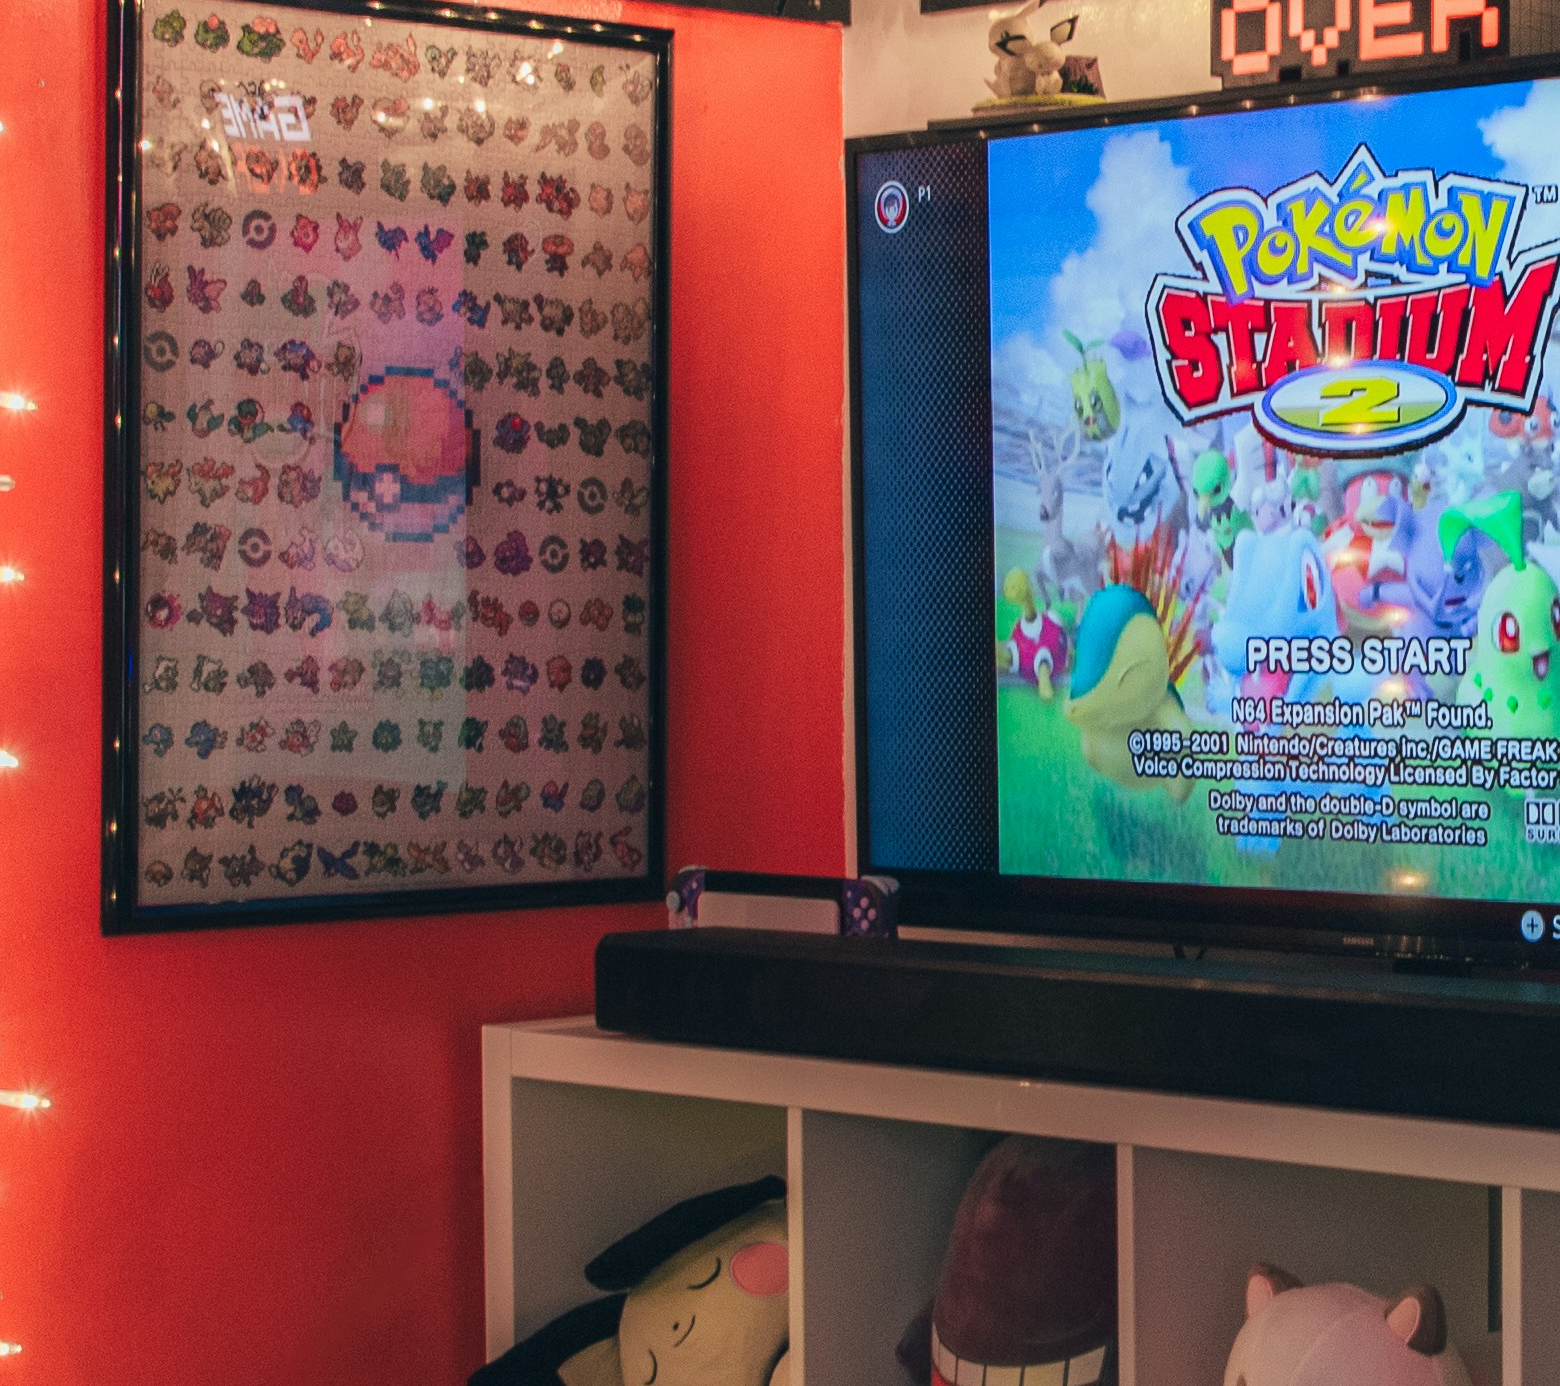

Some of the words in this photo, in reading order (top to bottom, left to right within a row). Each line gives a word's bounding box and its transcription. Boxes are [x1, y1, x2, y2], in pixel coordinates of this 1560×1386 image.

[918, 185, 931, 203] P1
[1158, 258, 1560, 410] STADIUM
[1320, 377, 1400, 426] 2
[1248, 638, 1353, 673] PRESS
[1362, 638, 1471, 674] START
[1232, 698, 1266, 722] N64
[1271, 698, 1364, 727] Expansion
[1426, 701, 1492, 727] Found.
[1236, 733, 1397, 759] Nintendo/Creatures
[1496, 740, 1558, 761] FREAK
[1134, 756, 1177, 777] Voice
[1181, 759, 1286, 780] Compression
[1290, 762, 1385, 785] Technology
[1390, 763, 1466, 784] Licensed
[1472, 766, 1495, 788] By
[1499, 768, 1556, 788] Factor
[1210, 789, 1255, 811] Dolby
[1258, 793, 1287, 811] and
[1291, 794, 1316, 812] the
[1320, 794, 1395, 816] double-D
[1399, 798, 1458, 819] symbol
[1462, 803, 1489, 820] are
[1217, 815, 1303, 836] trademarks
[1308, 819, 1326, 837] of
[1331, 821, 1377, 842] Dolby
[1382, 824, 1486, 844] Laboratories
